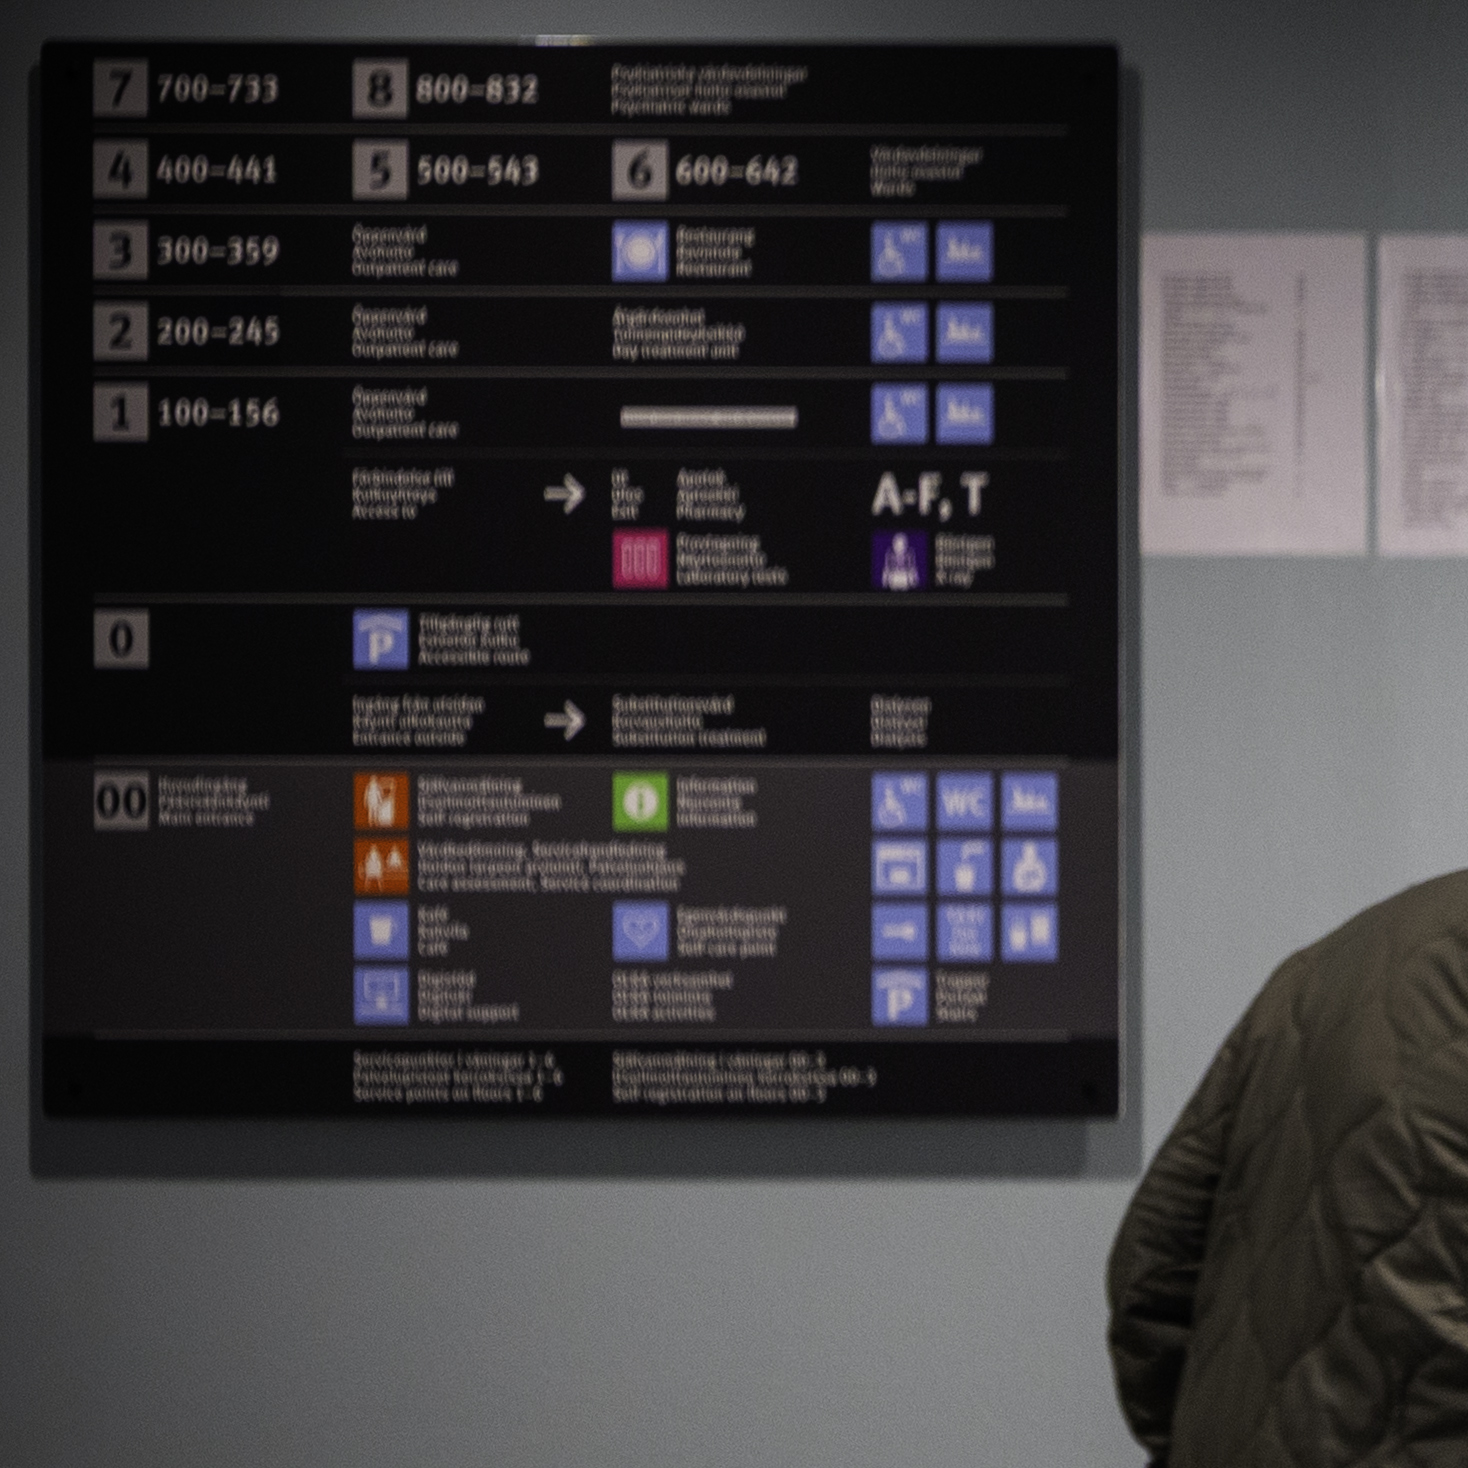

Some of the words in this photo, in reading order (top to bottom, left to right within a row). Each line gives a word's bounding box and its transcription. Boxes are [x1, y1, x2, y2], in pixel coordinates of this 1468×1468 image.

[107, 67, 135, 110] 7
[365, 68, 396, 109] 8
[106, 147, 136, 190] 4
[368, 150, 394, 190] 5
[626, 147, 655, 190] 6
[107, 229, 135, 271] 3
[107, 310, 135, 352] 2
[108, 391, 133, 432] 1
[959, 473, 991, 514] T
[107, 618, 136, 658] 0
[95, 781, 150, 820] 00
[941, 787, 987, 818] WC
